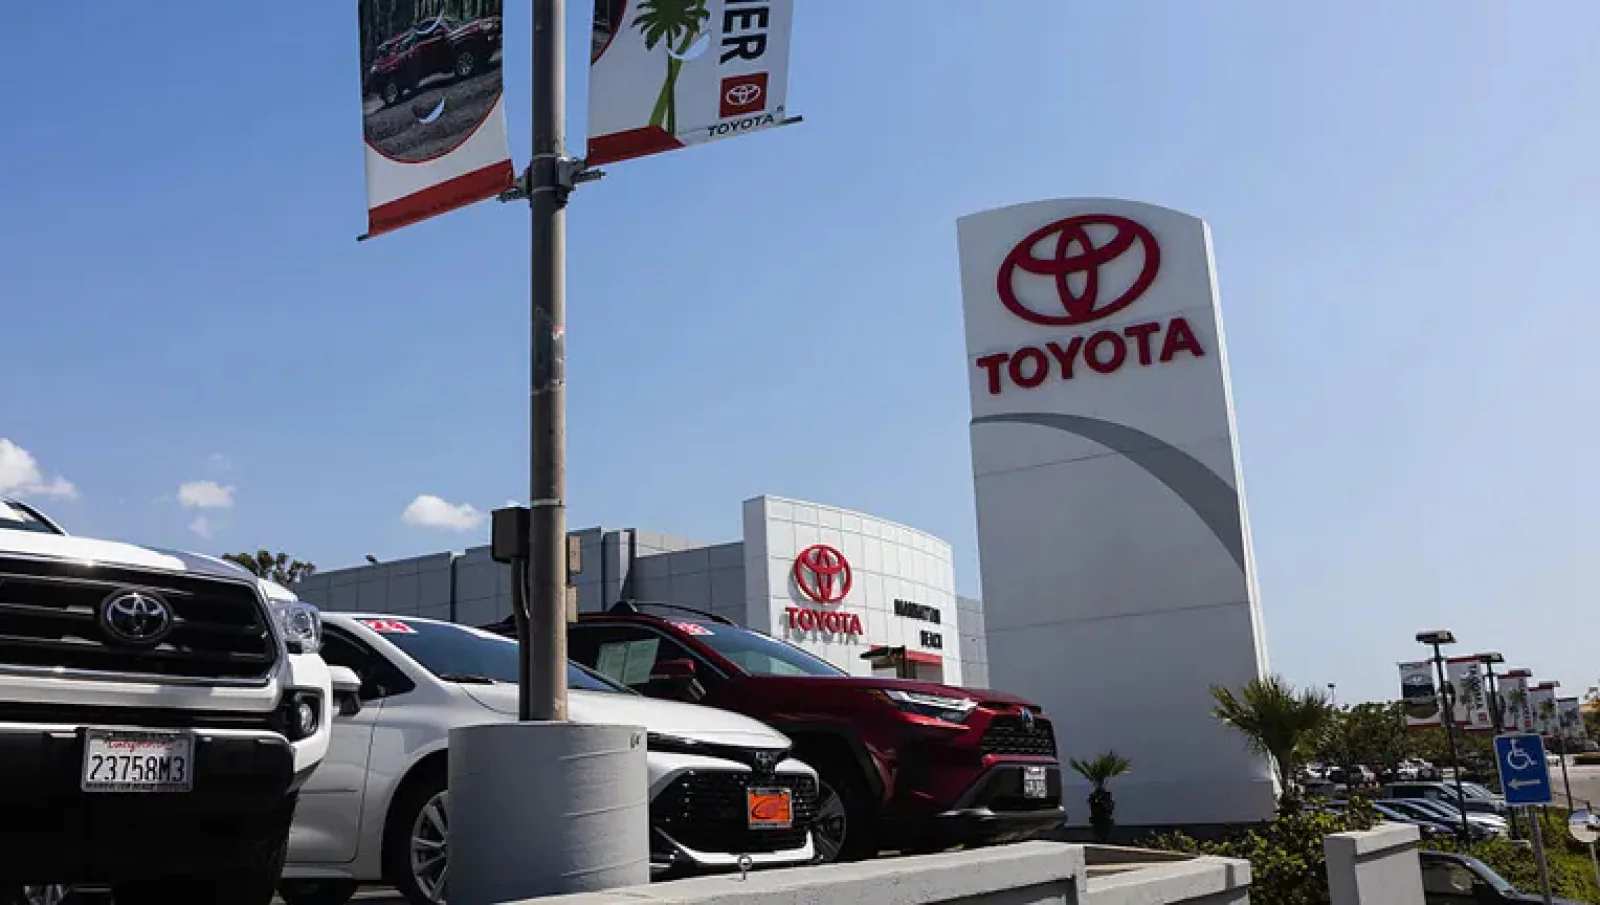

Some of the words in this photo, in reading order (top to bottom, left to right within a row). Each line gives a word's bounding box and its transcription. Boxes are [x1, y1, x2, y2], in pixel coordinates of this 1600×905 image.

[708, 114, 773, 136] TOYOTA
[976, 317, 1206, 395] TOYOTA
[785, 607, 864, 636] TOYOTA
